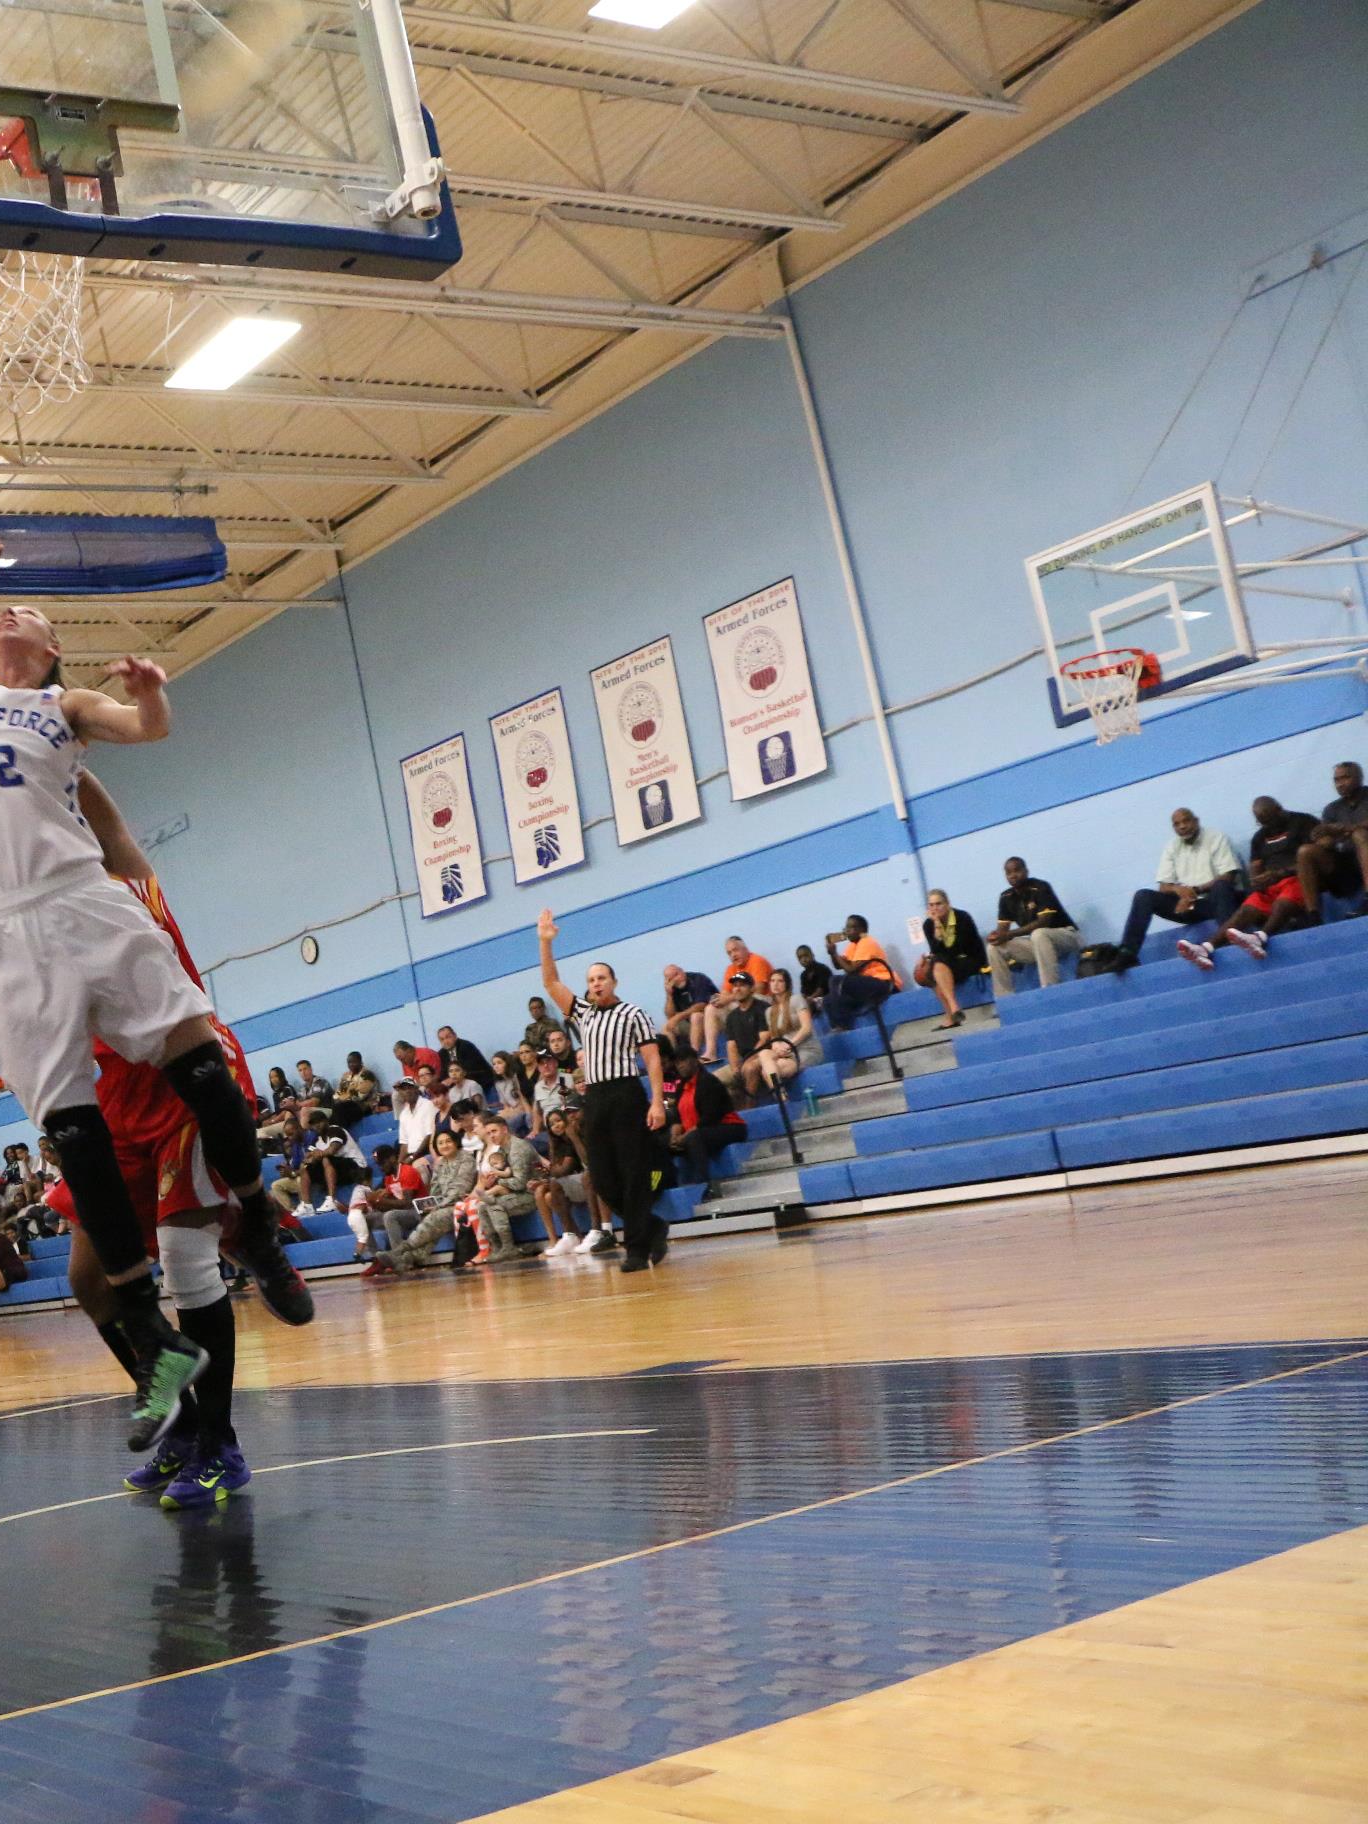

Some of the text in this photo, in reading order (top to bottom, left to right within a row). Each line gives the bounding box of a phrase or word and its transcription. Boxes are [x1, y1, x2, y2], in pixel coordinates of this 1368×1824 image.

[1054, 543, 1097, 568] DUNKING
[1099, 537, 1114, 549] OR
[1117, 517, 1162, 542] HANGING
[1166, 510, 1181, 523] ON
[715, 597, 788, 636] Armed Forces
[730, 605, 743, 615] OF
[746, 596, 764, 607] THE
[601, 655, 665, 689] Armed Forces
[615, 661, 626, 671] OF
[528, 707, 556, 722] Forces
[743, 707, 800, 735] Championship
[408, 751, 460, 778] Armed Forces
[625, 764, 678, 788] Championship
[518, 804, 569, 829] Championship
[424, 844, 471, 867] Championship
